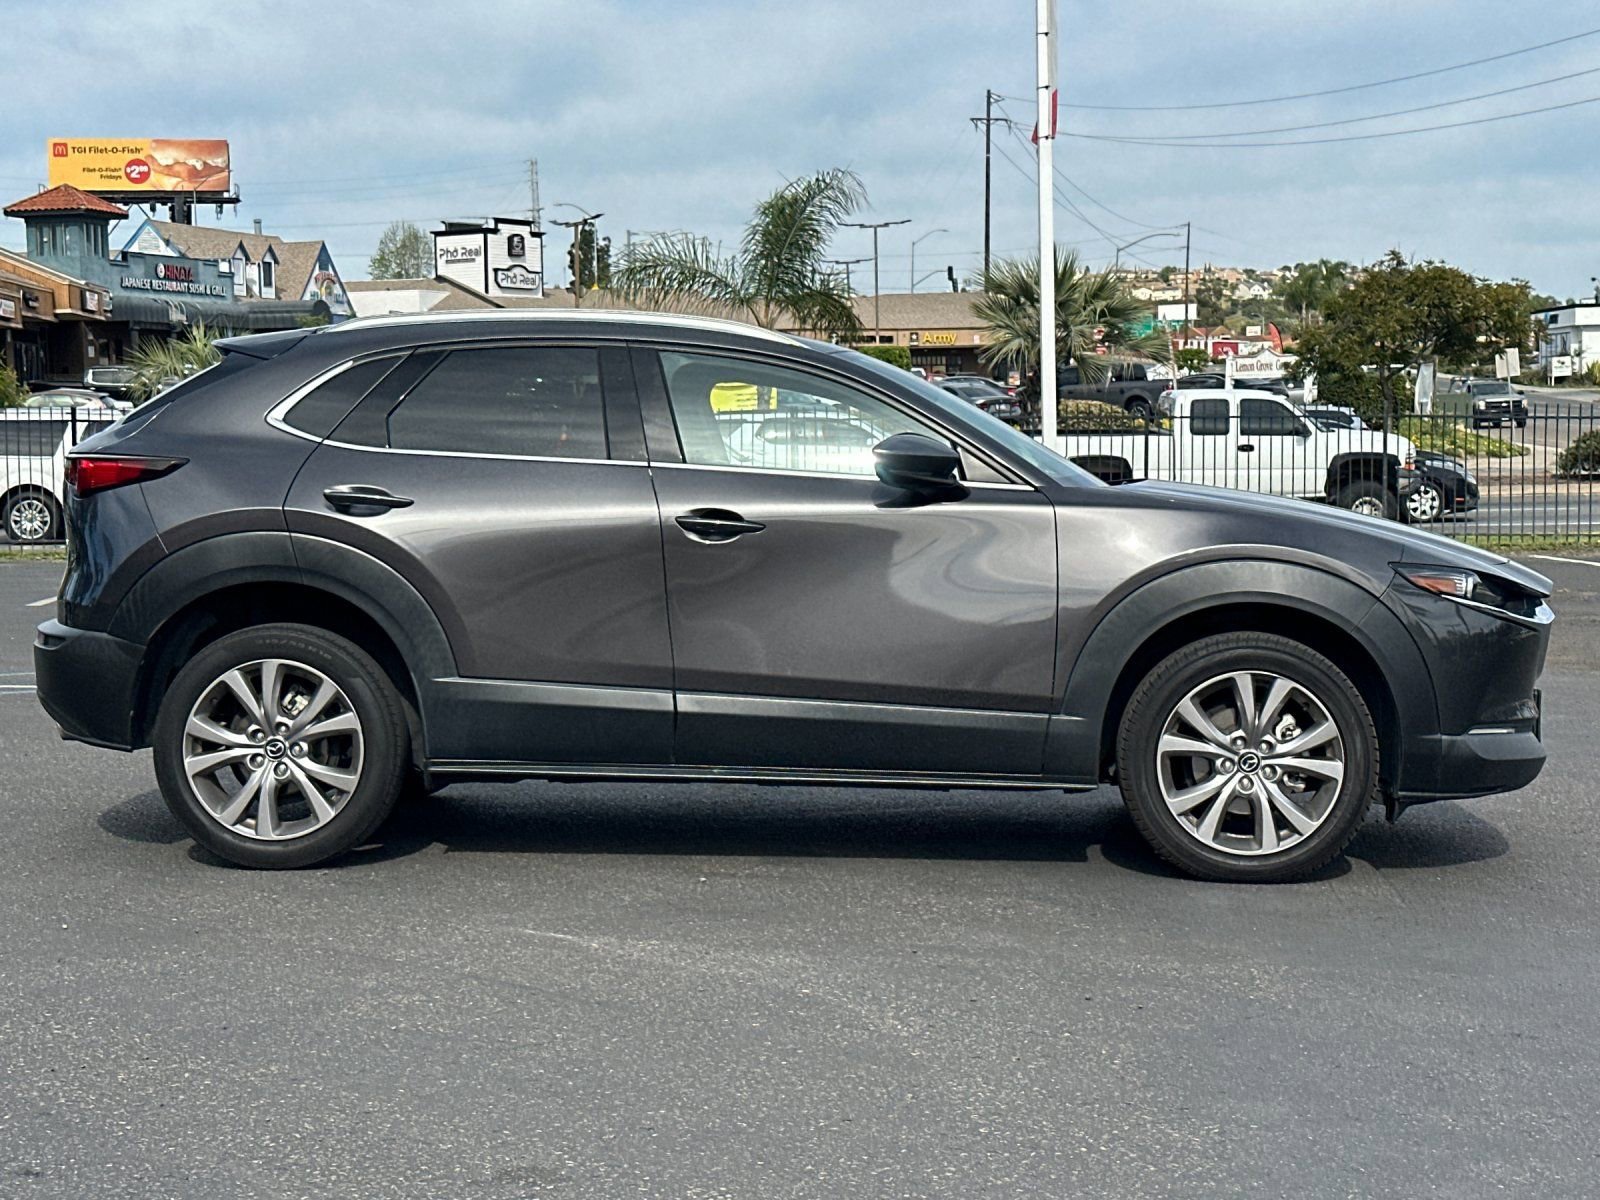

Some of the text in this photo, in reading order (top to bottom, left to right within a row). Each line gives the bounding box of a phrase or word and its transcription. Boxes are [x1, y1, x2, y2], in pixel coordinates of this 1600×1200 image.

[71, 146, 87, 154] TGI
[460, 245, 482, 258] Real
[122, 276, 151, 291] JAPANESE
[151, 279, 188, 293] RESTAURANT
[188, 283, 206, 294] SUSHI
[211, 285, 227, 296] GRILL
[519, 273, 537, 286] Real
[922, 331, 957, 345] Army
[1235, 360, 1255, 372] Lemon
[1256, 359, 1273, 371] Grove
